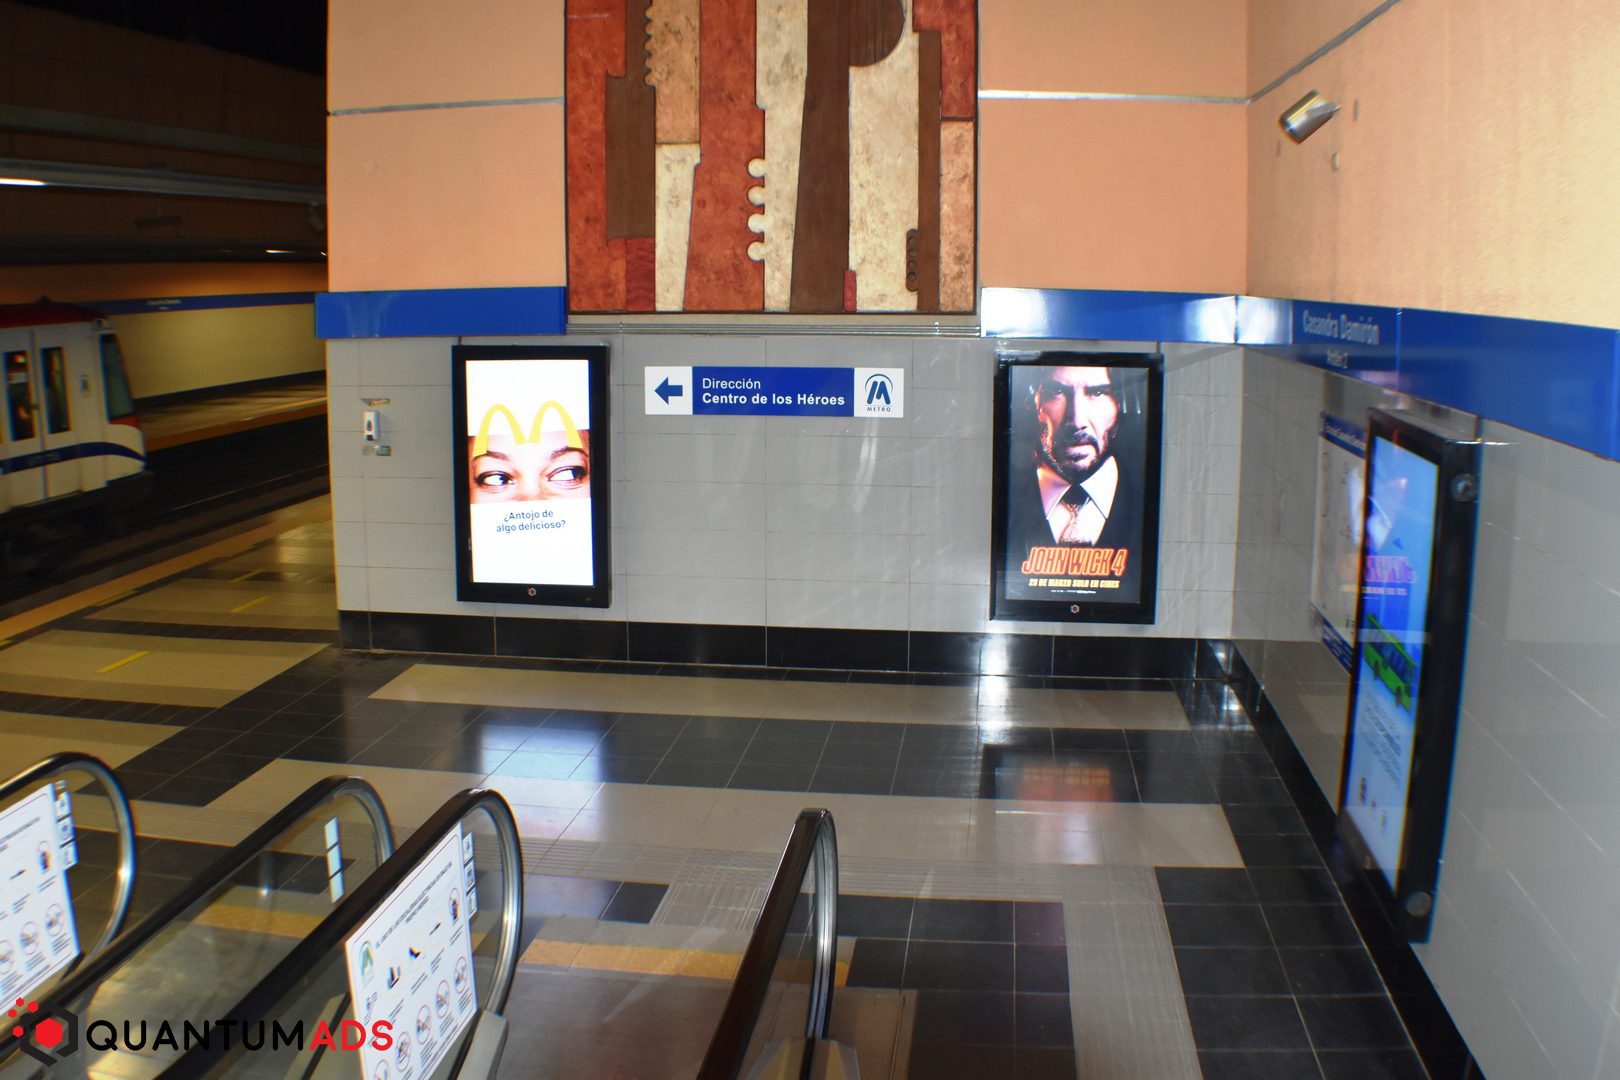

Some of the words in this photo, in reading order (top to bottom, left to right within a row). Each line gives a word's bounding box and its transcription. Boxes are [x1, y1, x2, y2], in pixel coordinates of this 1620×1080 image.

[1302, 309, 1339, 338] Casandra
[1341, 314, 1378, 345] Damirón
[702, 378, 761, 390] Dirección
[702, 392, 746, 404] Centro
[751, 393, 768, 404] de
[772, 393, 793, 405] los
[797, 393, 845, 406] Héroes
[503, 510, 540, 523] ¿Antojo
[542, 509, 554, 518] de
[496, 522, 517, 534] algo
[518, 519, 566, 531] delicioso?
[1021, 547, 1069, 575] JOHN
[1068, 548, 1114, 576] WICK
[1111, 549, 1128, 576] 4
[1039, 578, 1048, 587] DE
[1048, 579, 1072, 588] MARZO
[1072, 579, 1089, 588] SOLO
[1099, 580, 1120, 589] CINES
